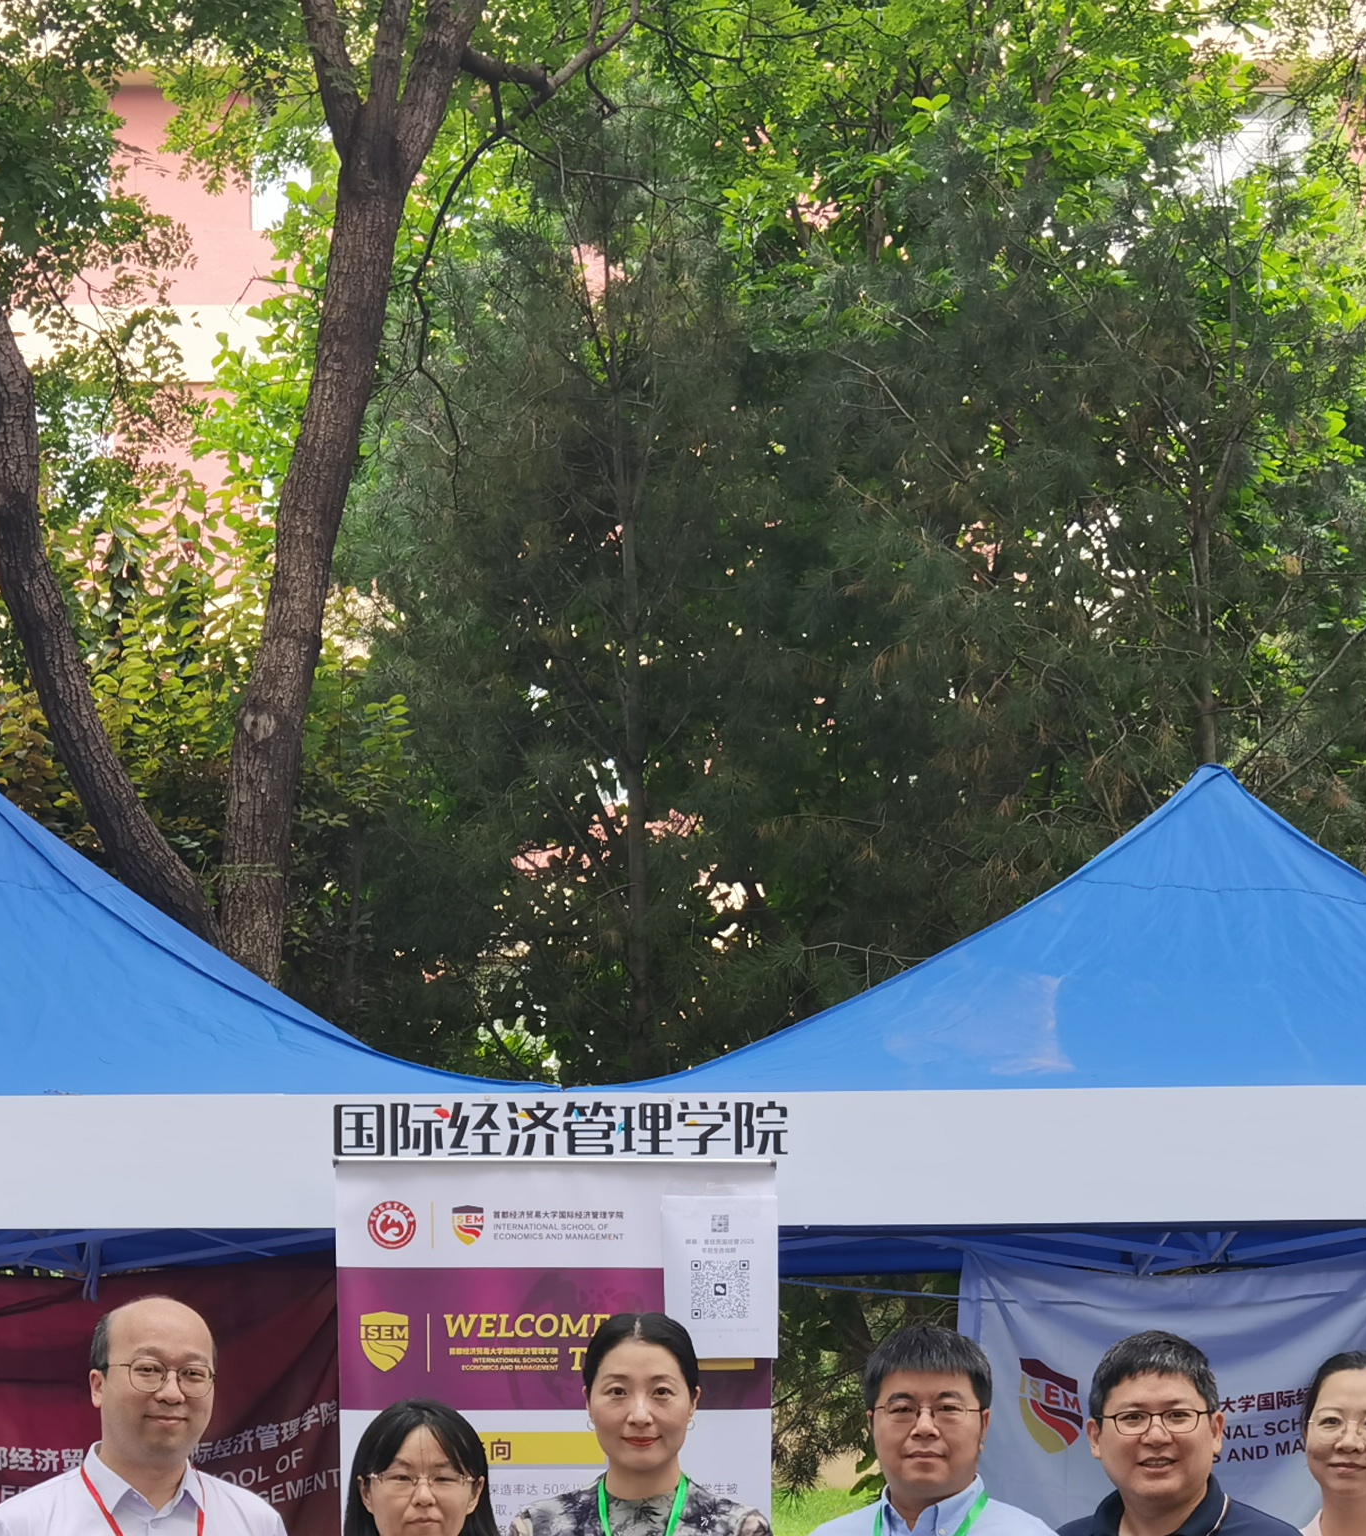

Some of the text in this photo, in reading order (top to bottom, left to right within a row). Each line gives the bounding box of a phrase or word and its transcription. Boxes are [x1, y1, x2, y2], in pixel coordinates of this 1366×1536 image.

[334, 1101, 788, 1156] 国际经济管理学院
[452, 1215, 484, 1224] ISEM
[493, 1223, 609, 1231] INTERNATIONAL SCHOOL OF
[360, 1326, 409, 1340] ISEM
[1019, 1373, 1082, 1414] ISEM
[481, 1439, 511, 1461] 向
[1227, 1445, 1269, 1462] AND
[276, 1448, 303, 1473] OF
